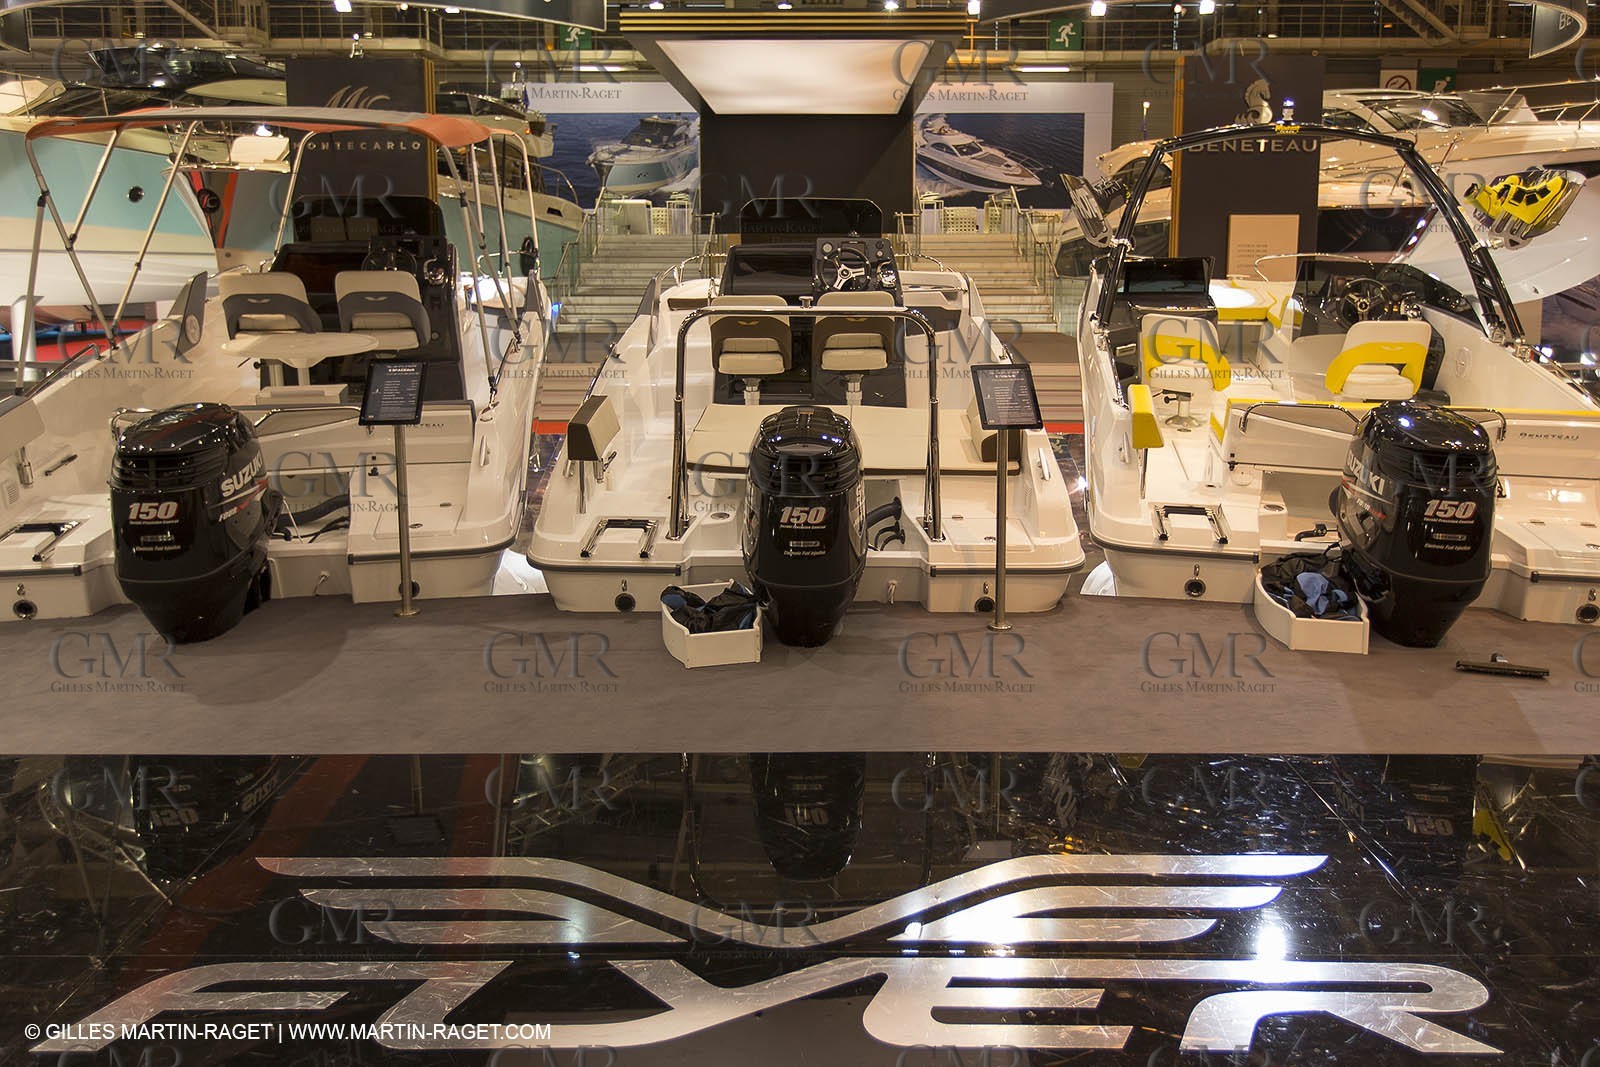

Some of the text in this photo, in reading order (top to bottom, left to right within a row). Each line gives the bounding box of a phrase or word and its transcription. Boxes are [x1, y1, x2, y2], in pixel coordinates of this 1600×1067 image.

[129, 502, 179, 521] 150
[780, 506, 826, 525] 150
[1424, 499, 1476, 519] 150
[30, 956, 1504, 1054] FLYER
